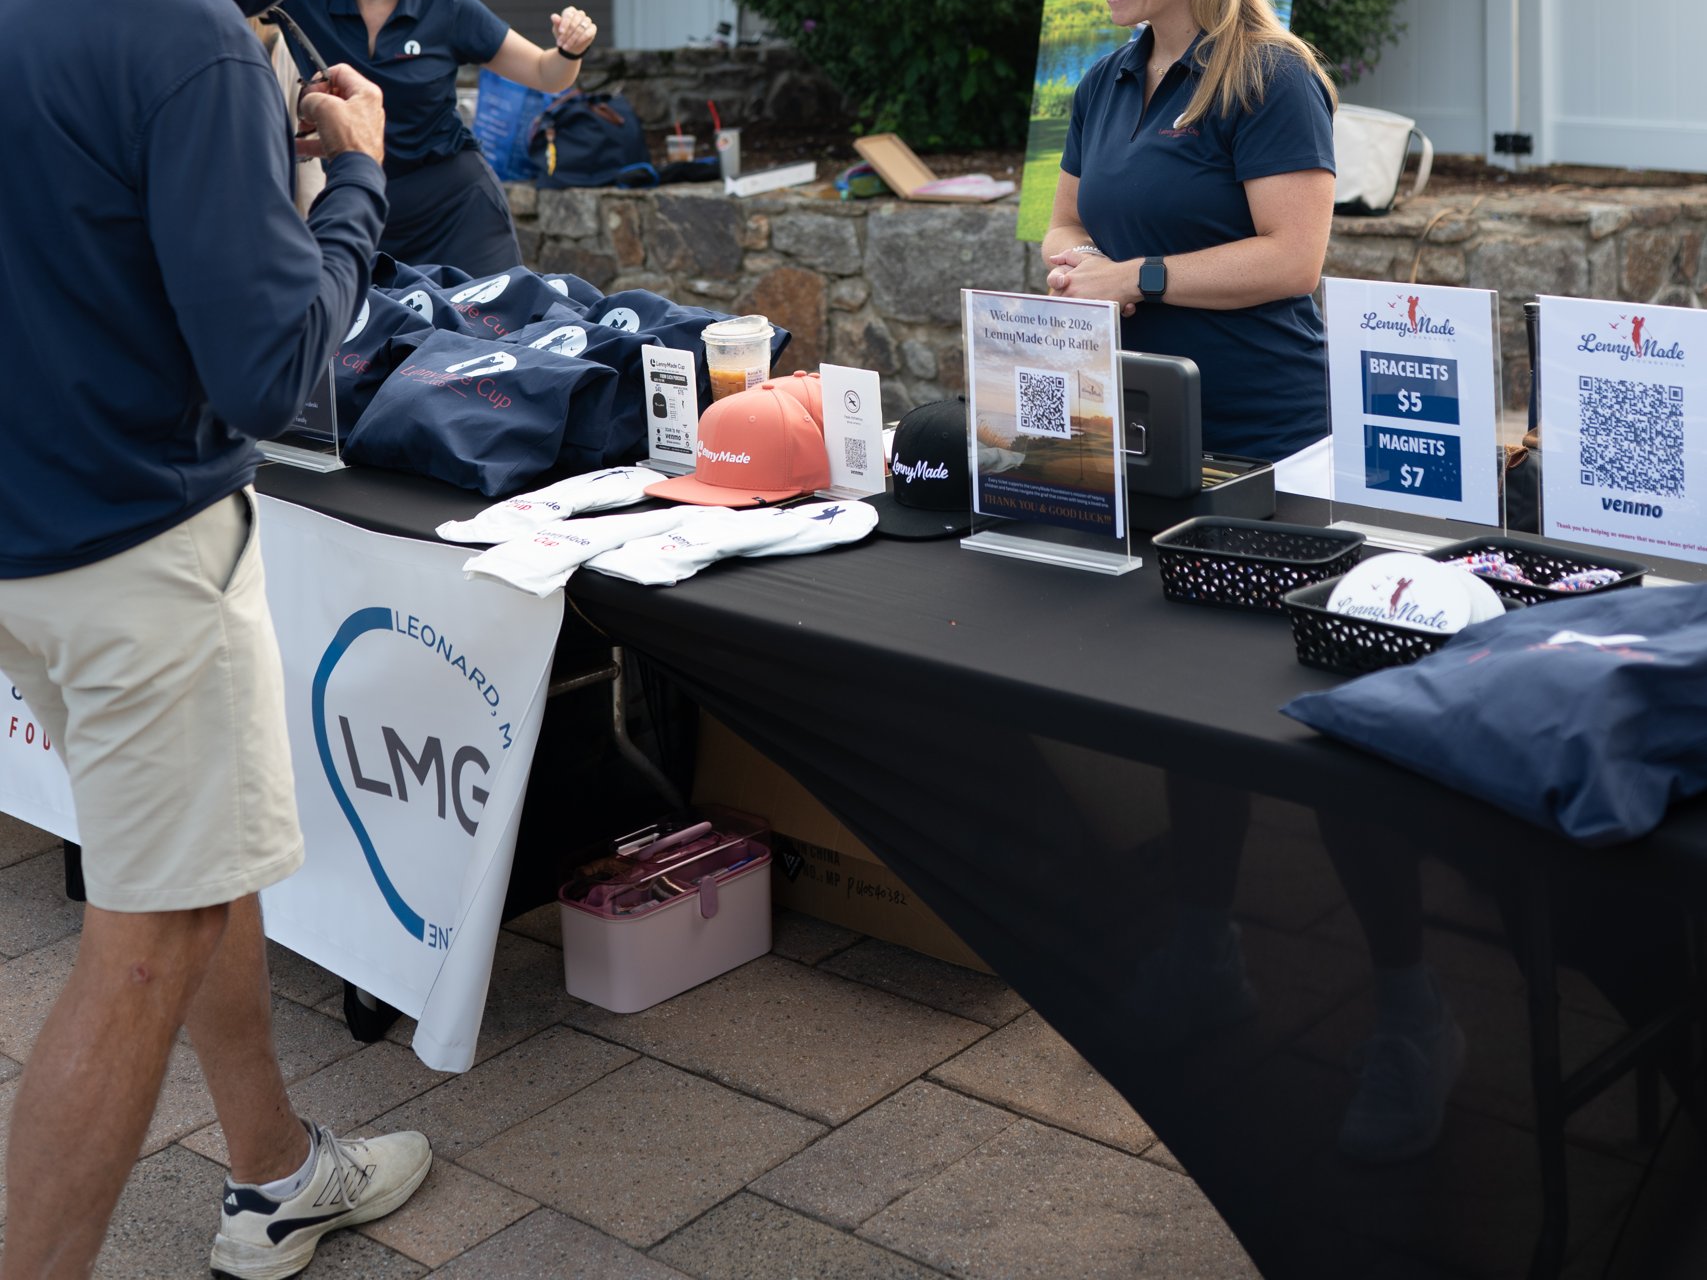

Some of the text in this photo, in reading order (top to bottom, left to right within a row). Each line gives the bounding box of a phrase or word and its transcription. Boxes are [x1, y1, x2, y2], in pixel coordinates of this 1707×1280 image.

[989, 309, 1093, 332] Welcome to the 2026
[984, 327, 1100, 352] LennyMade Cup Raffle
[1369, 358, 1449, 382] BRACELETS
[476, 378, 512, 409] Cup
[1397, 388, 1423, 413] $5
[1379, 433, 1446, 457] MAGNETS
[892, 452, 950, 483] LennyMade
[1400, 463, 1425, 488] $7
[984, 493, 1017, 508] THANK
[1019, 499, 1038, 511] YOU
[1039, 503, 1047, 513] &
[1048, 505, 1077, 519] GOOD
[1601, 497, 1664, 519] venmo
[534, 536, 560, 548] Cup
[1556, 521, 1572, 530] Thank
[1572, 524, 1581, 532] you
[1590, 527, 1610, 538] helping
[1636, 535, 1648, 543] that
[338, 715, 491, 838] LMG
[810, 845, 841, 866] CHINA
[825, 870, 841, 888] MP
